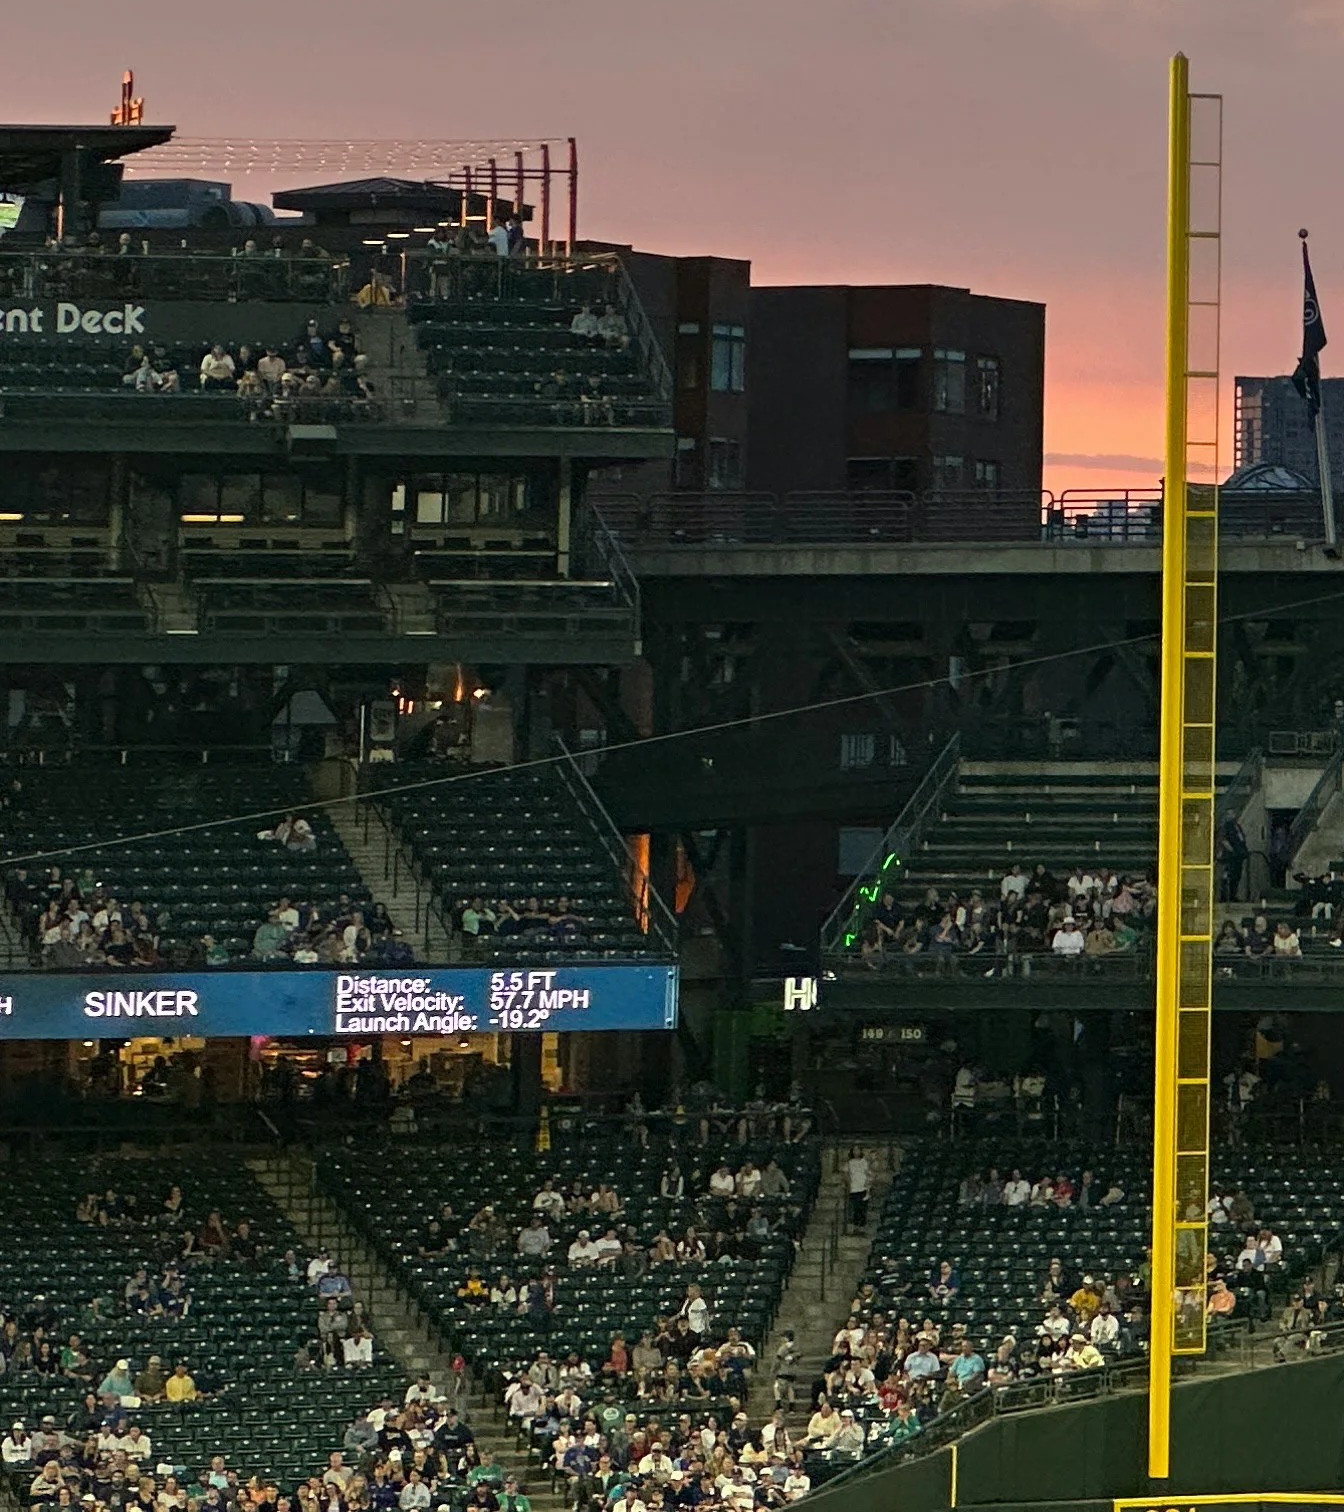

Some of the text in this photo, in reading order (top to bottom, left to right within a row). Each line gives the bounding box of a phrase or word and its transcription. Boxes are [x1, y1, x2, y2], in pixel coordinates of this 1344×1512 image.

[0, 303, 145, 334] nt Deck
[337, 971, 556, 994] Distance: 5.5 FT
[784, 977, 817, 1010] H
[84, 991, 198, 1017] SINKER
[336, 990, 588, 1014] Exit Velocity: 57.7 MPH
[335, 1013, 410, 1032] Launch
[413, 1013, 477, 1034] Angle:
[901, 1028, 921, 1039] 150
